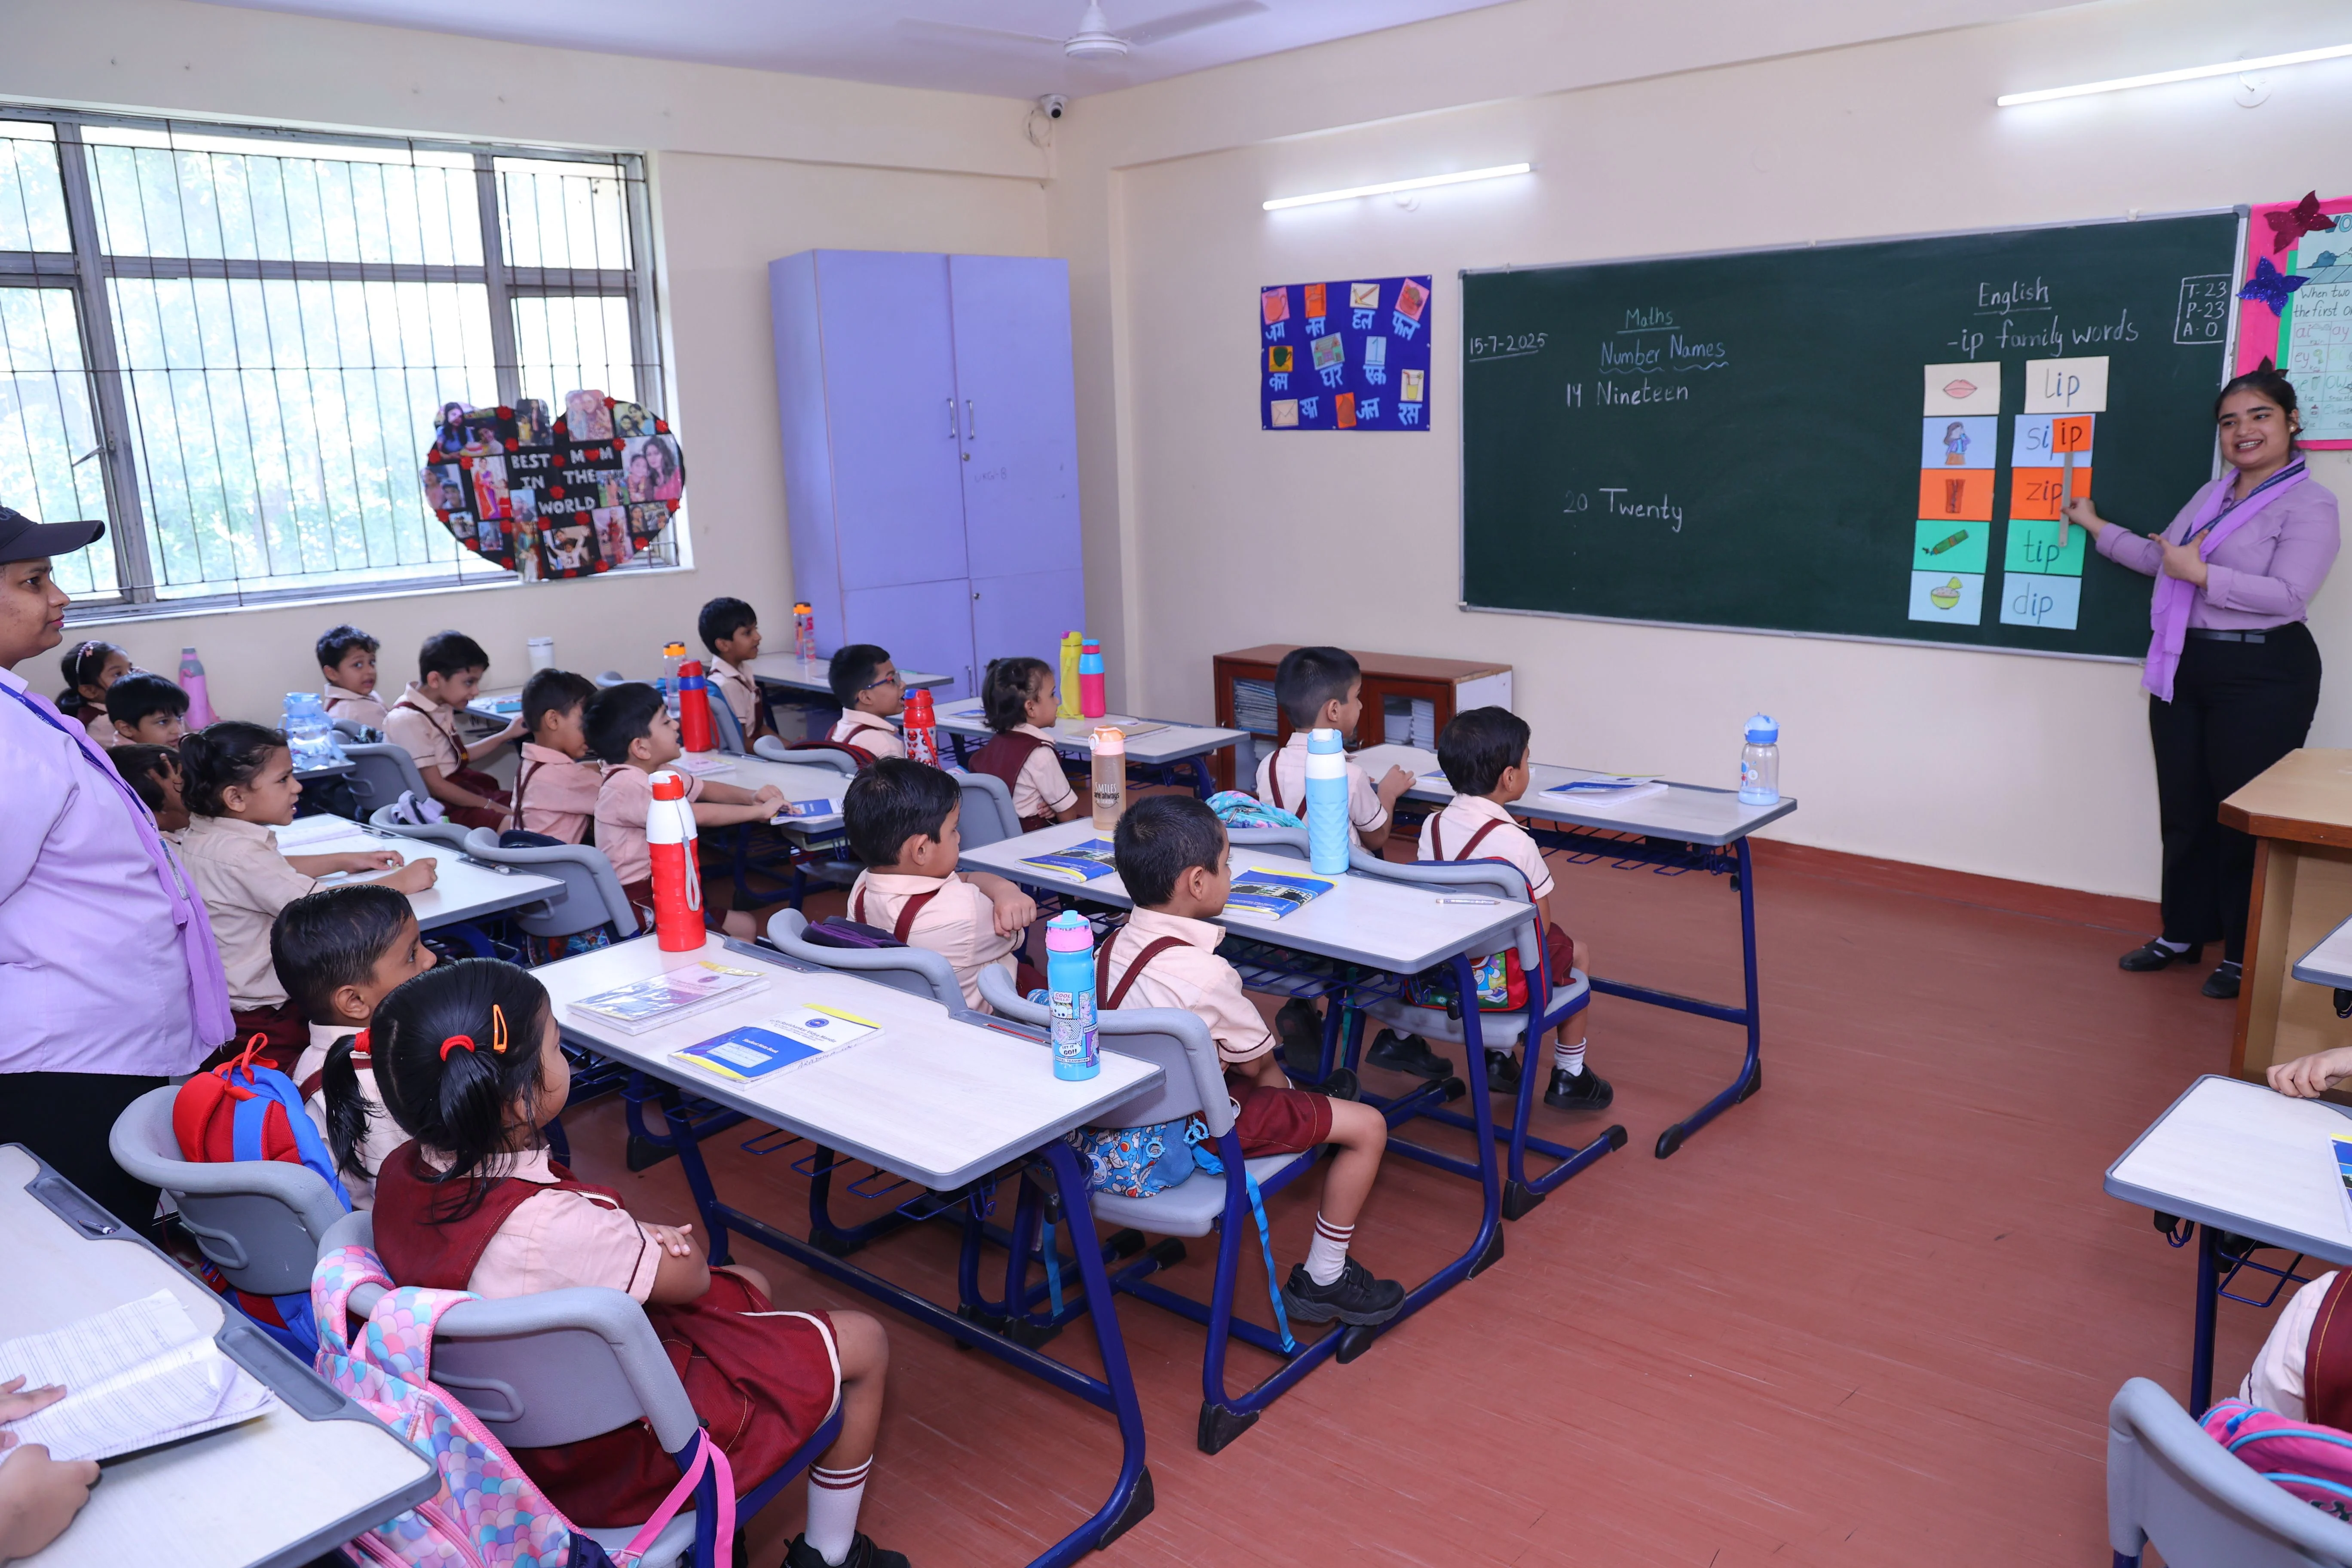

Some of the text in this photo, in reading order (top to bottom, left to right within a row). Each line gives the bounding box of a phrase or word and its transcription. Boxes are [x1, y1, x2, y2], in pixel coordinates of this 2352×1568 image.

[1978, 276, 2050, 312] English
[2300, 285, 2350, 298] When two
[1352, 309, 1375, 330] हल
[1625, 306, 1673, 329] Maths
[2293, 304, 2310, 317] the
[2312, 300, 2338, 316] first
[1265, 322, 1285, 342] जग
[1305, 316, 1326, 337] नल
[1392, 310, 1421, 340] फल
[1947, 309, 2139, 359] -ip family words
[2295, 324, 2312, 338] ai
[2332, 325, 2349, 342] ay
[1470, 332, 1548, 355] 15-7-2025
[1601, 334, 1726, 366] Number Names
[2294, 351, 2310, 368] ey
[1320, 363, 1343, 389] घर
[1363, 364, 1387, 386] एक
[1597, 377, 1688, 406] Nineteen
[2045, 368, 2080, 407] lip
[1356, 397, 1380, 420] जल
[1398, 403, 1422, 426] रस
[2026, 426, 2053, 460] si
[511, 453, 551, 469] BEST
[520, 469, 597, 490] IN THE
[538, 497, 596, 515] WORLD
[2026, 481, 2063, 515] zip
[1563, 487, 1683, 533] 20 Twenty
[2024, 530, 2060, 573] tip
[2013, 586, 2053, 624] dip
[1095, 781, 1117, 793] SMILES
